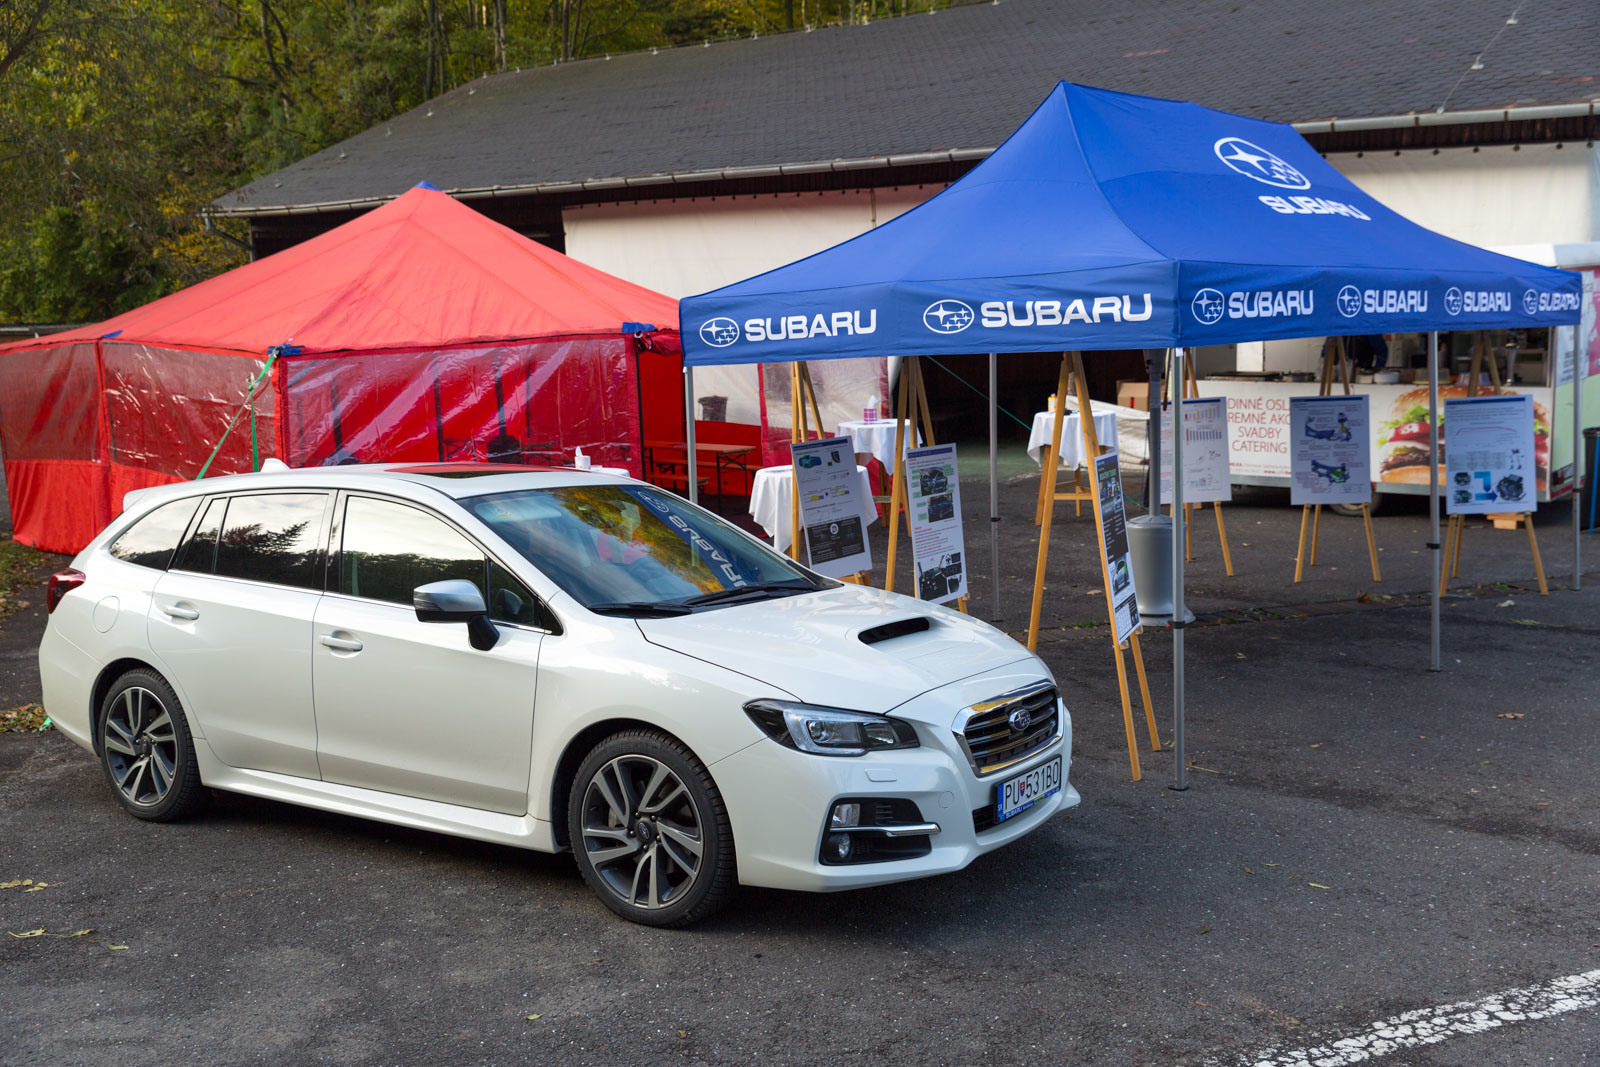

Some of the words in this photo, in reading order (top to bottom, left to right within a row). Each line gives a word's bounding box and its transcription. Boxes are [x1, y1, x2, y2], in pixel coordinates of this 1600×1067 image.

[1258, 195, 1372, 221] SUBARU
[980, 293, 1153, 328] SUBARU
[1228, 289, 1314, 319] SUBARU
[1363, 289, 1428, 313] SUBARU
[1463, 291, 1512, 312] SUBARU
[1538, 291, 1580, 311] SUBARU
[744, 308, 877, 342] SUBARU
[1238, 426, 1282, 439] SVADBY
[1231, 440, 1288, 454] CATERING
